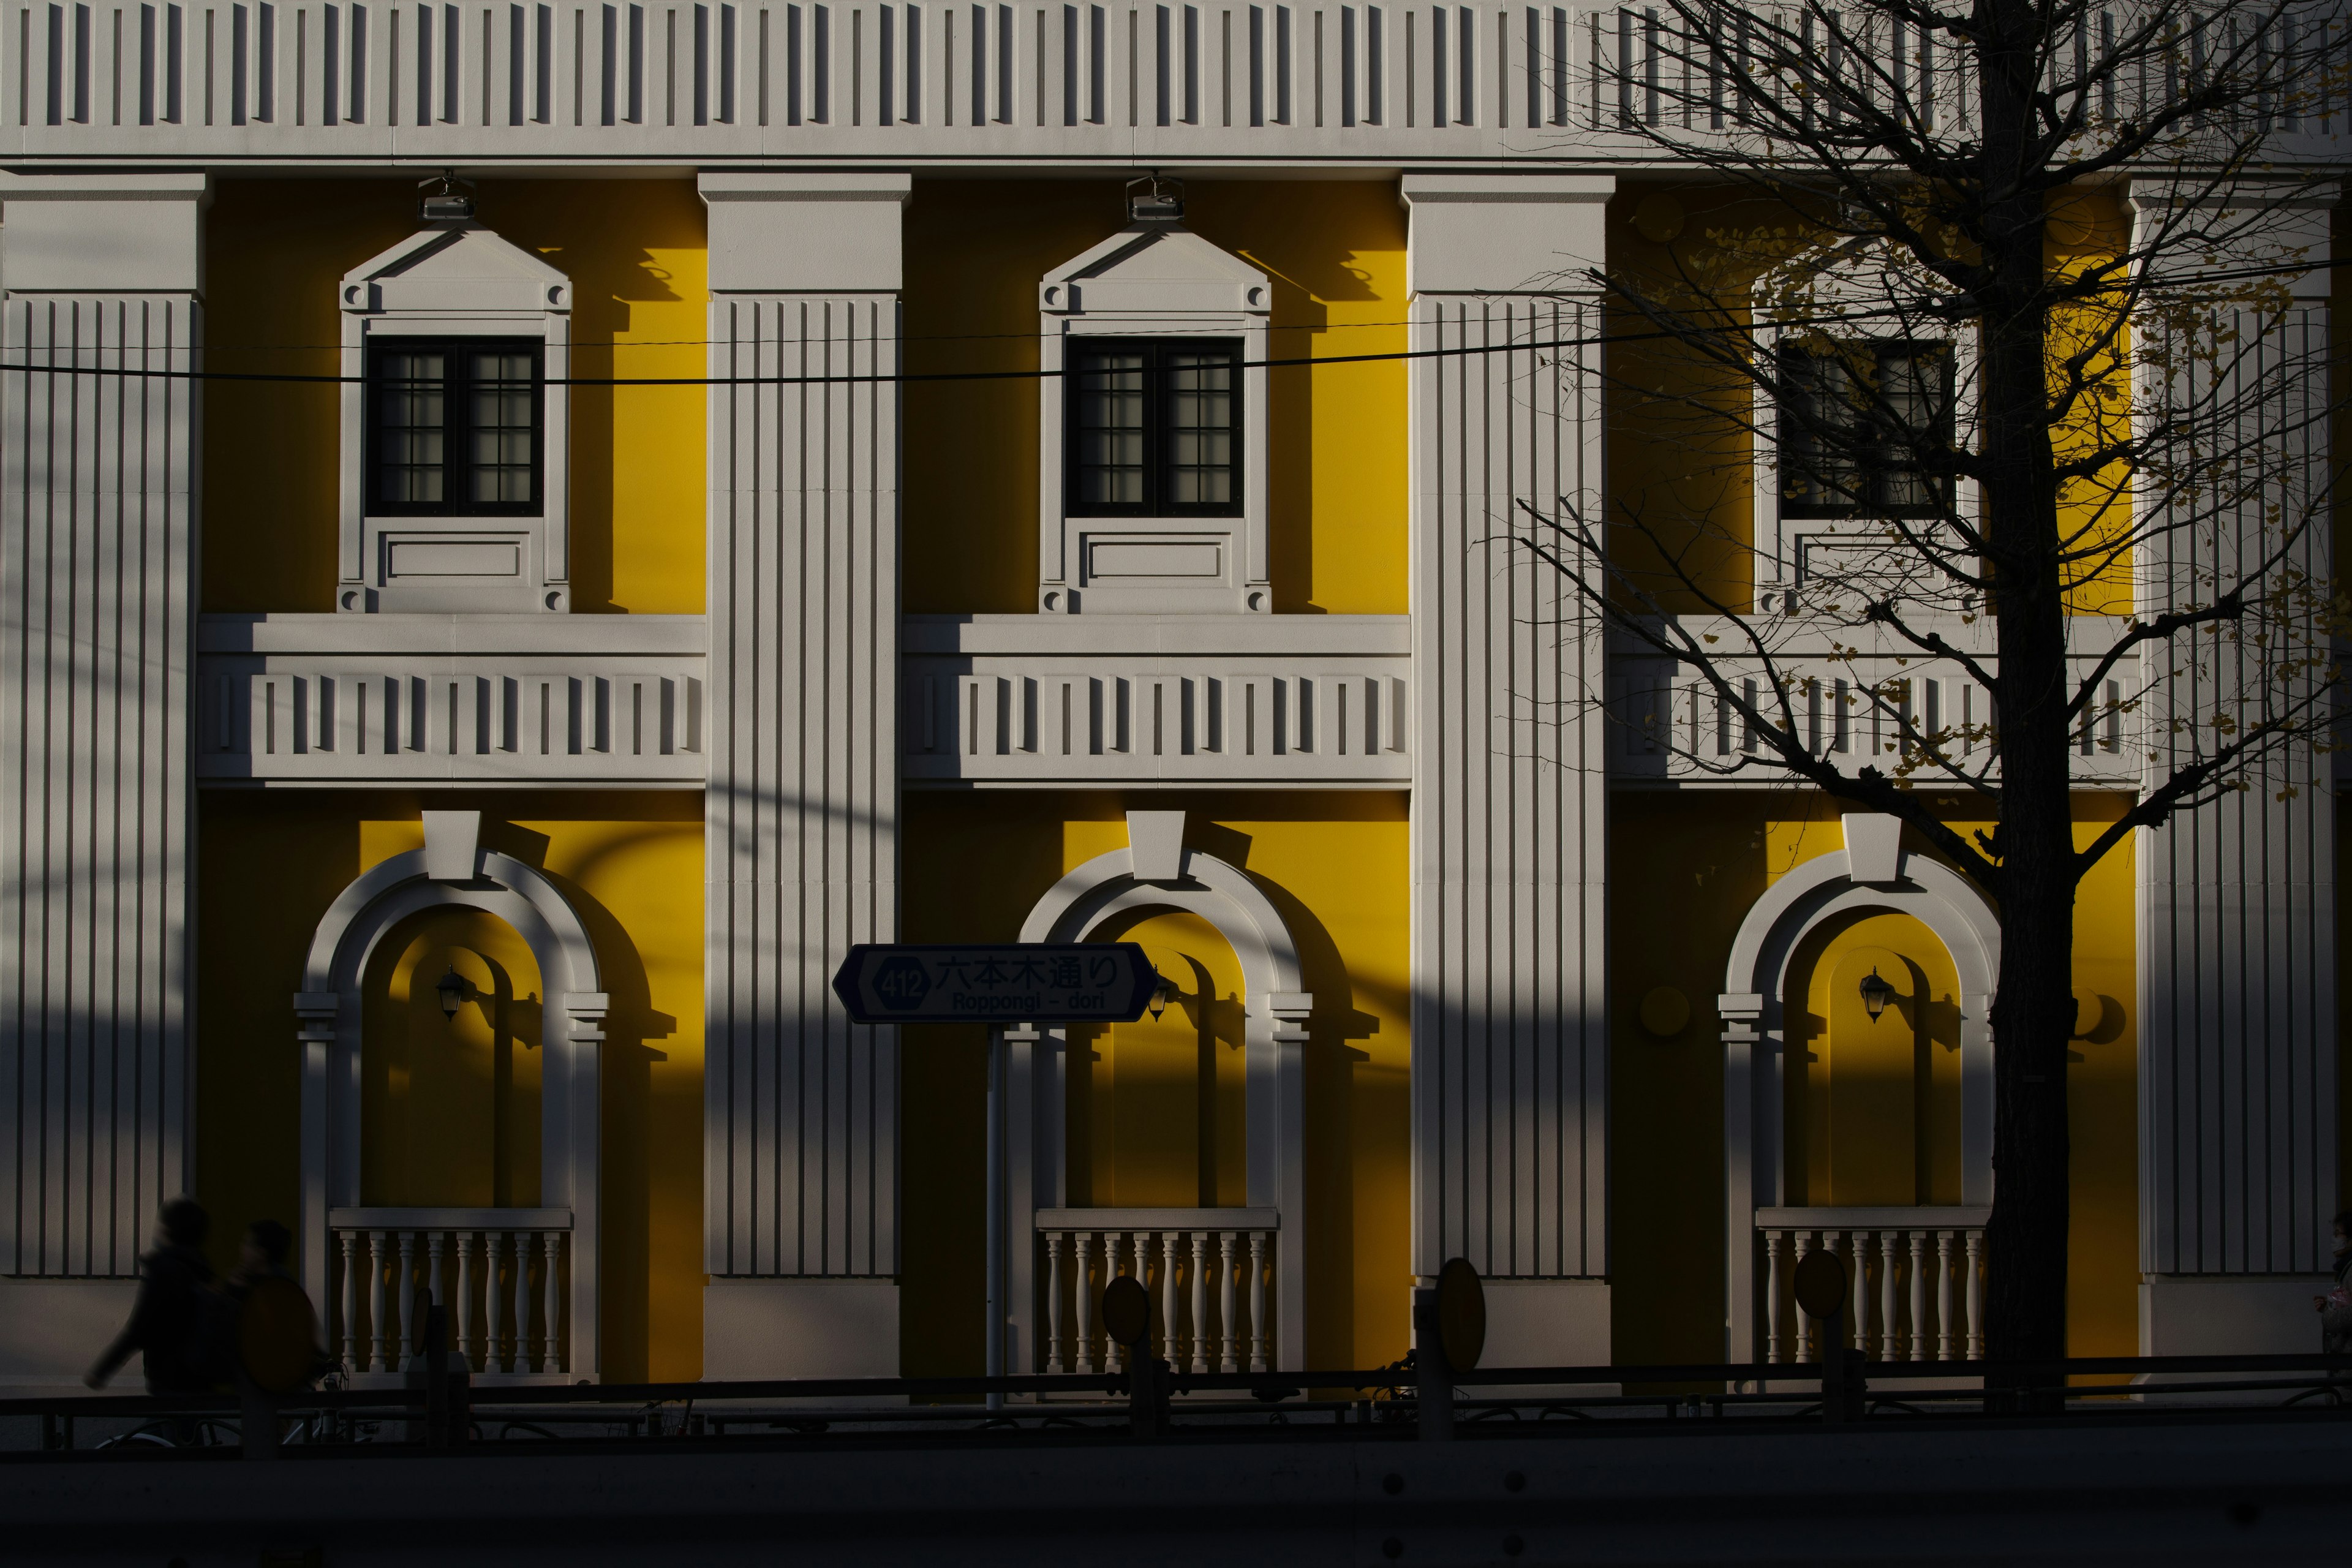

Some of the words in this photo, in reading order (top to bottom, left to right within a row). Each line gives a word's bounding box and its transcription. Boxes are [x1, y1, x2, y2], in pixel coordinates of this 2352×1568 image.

[882, 970, 922, 997] 412
[936, 956, 1117, 990] 六本木通り
[952, 992, 1041, 1013] Roppongi
[1069, 992, 1104, 1009] dori
